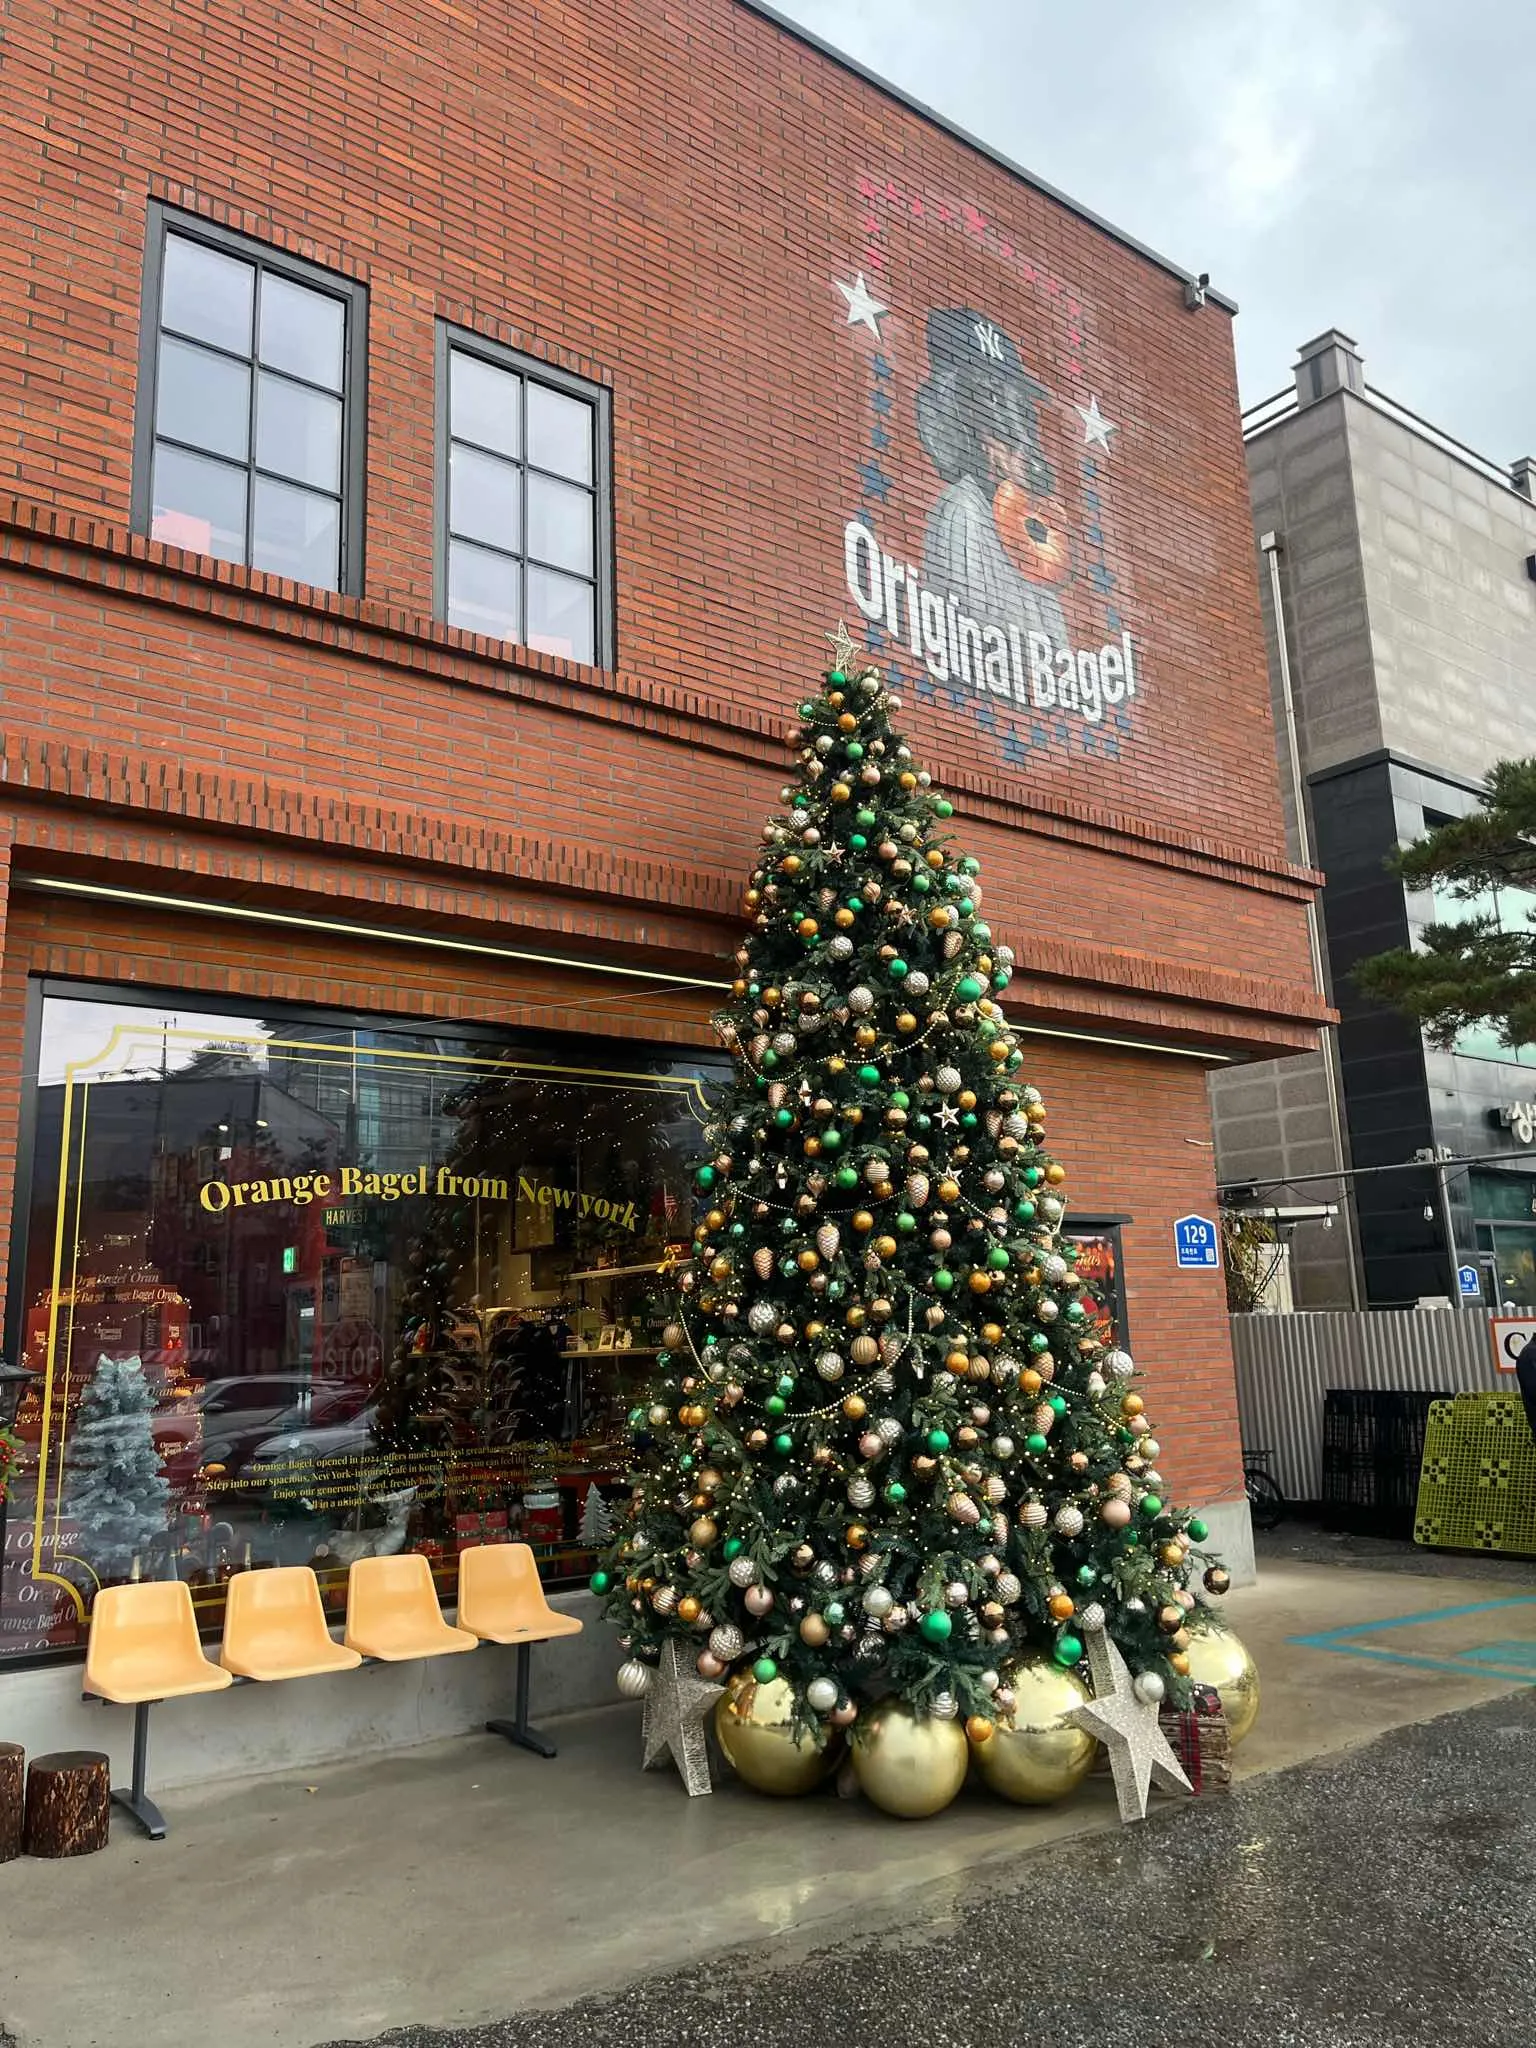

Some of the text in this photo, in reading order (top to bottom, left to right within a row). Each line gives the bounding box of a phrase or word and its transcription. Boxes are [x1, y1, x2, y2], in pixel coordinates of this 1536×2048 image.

[844, 521, 1135, 722] Original Bagel
[1505, 1100, 1536, 1144] 상
[200, 1170, 331, 1212] Orange
[339, 1165, 428, 1201] Bagel
[436, 1166, 508, 1200] from
[1183, 1224, 1208, 1244] 129
[316, 1455, 348, 1468] opened
[349, 1455, 358, 1465] in
[206, 1480, 229, 1491] Step
[230, 1478, 250, 1489] into
[250, 1477, 268, 1487] our
[311, 1471, 331, 1481] New
[408, 1463, 417, 1473] in
[17, 1531, 79, 1549] Oange
